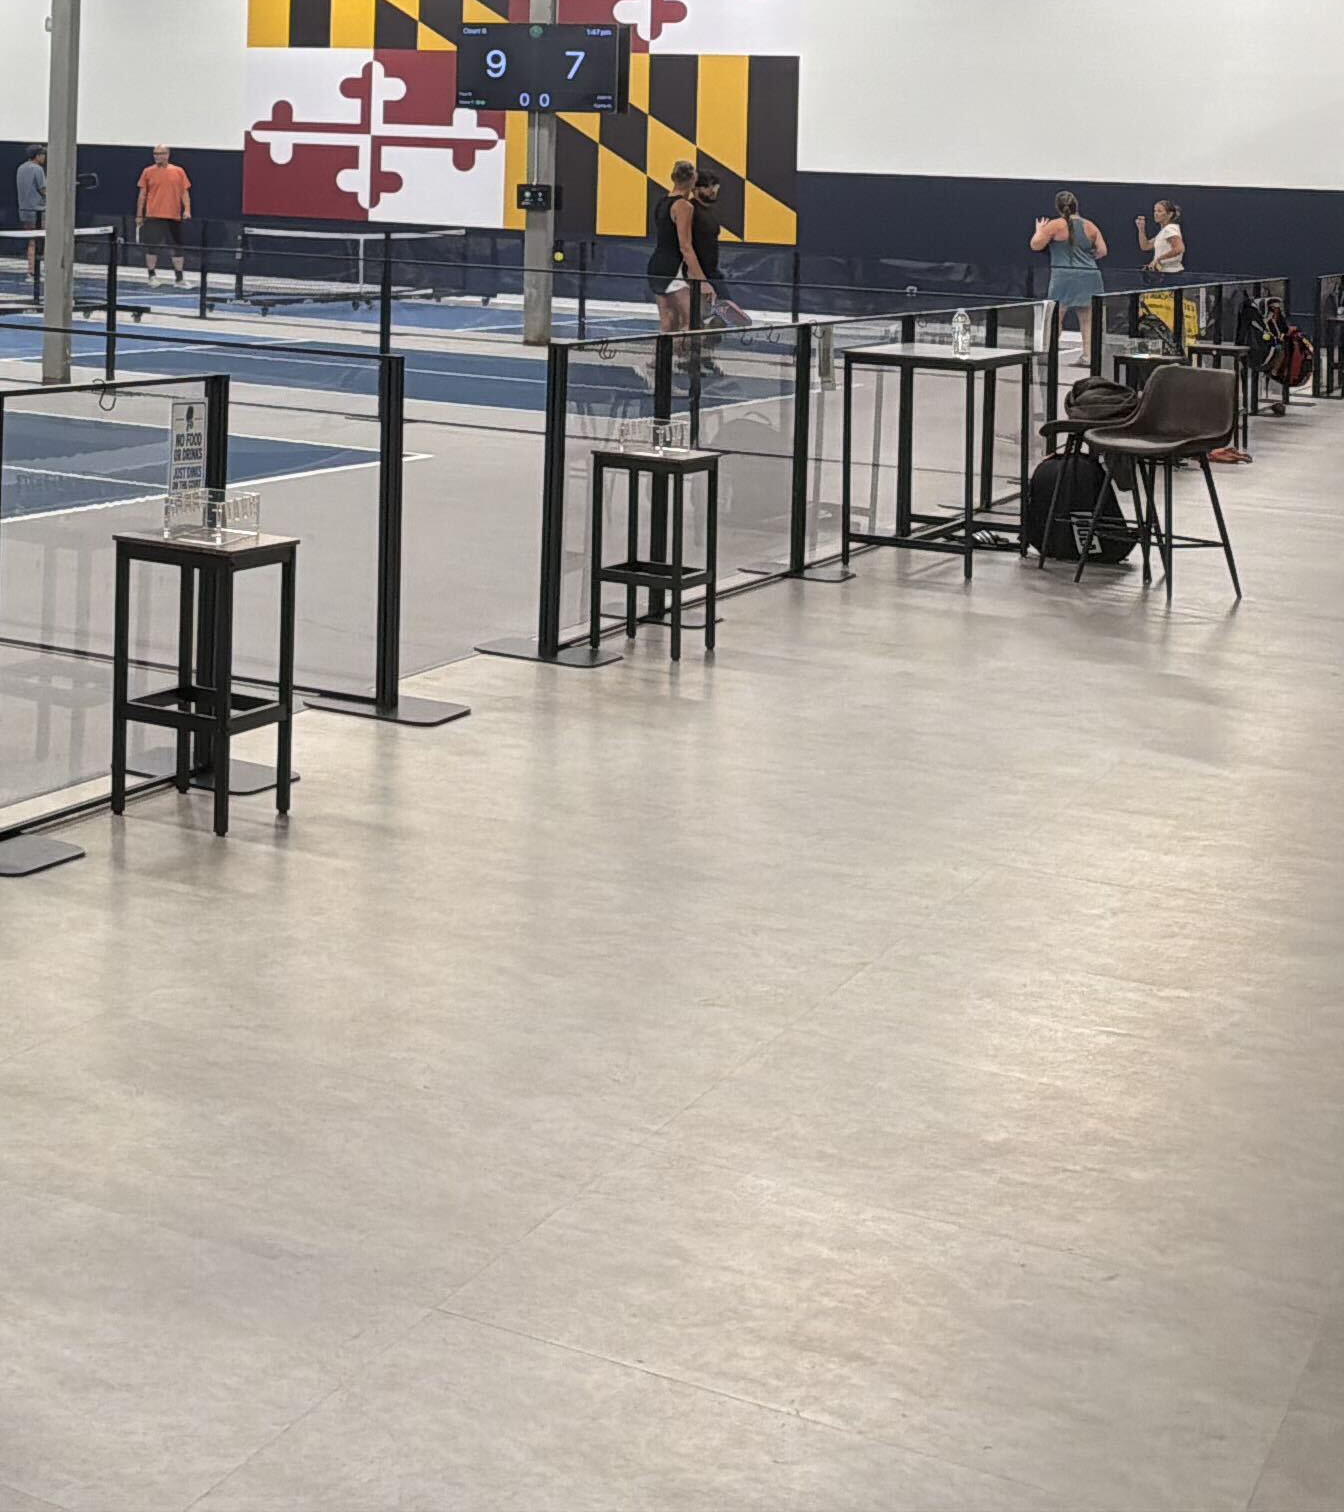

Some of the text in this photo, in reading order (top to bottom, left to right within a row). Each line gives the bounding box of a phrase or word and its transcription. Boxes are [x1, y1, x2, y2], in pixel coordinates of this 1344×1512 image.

[486, 50, 507, 78] 9
[565, 51, 586, 80] 7
[519, 92, 531, 107] 0
[539, 93, 550, 108] 0
[186, 432, 202, 446] FOOD
